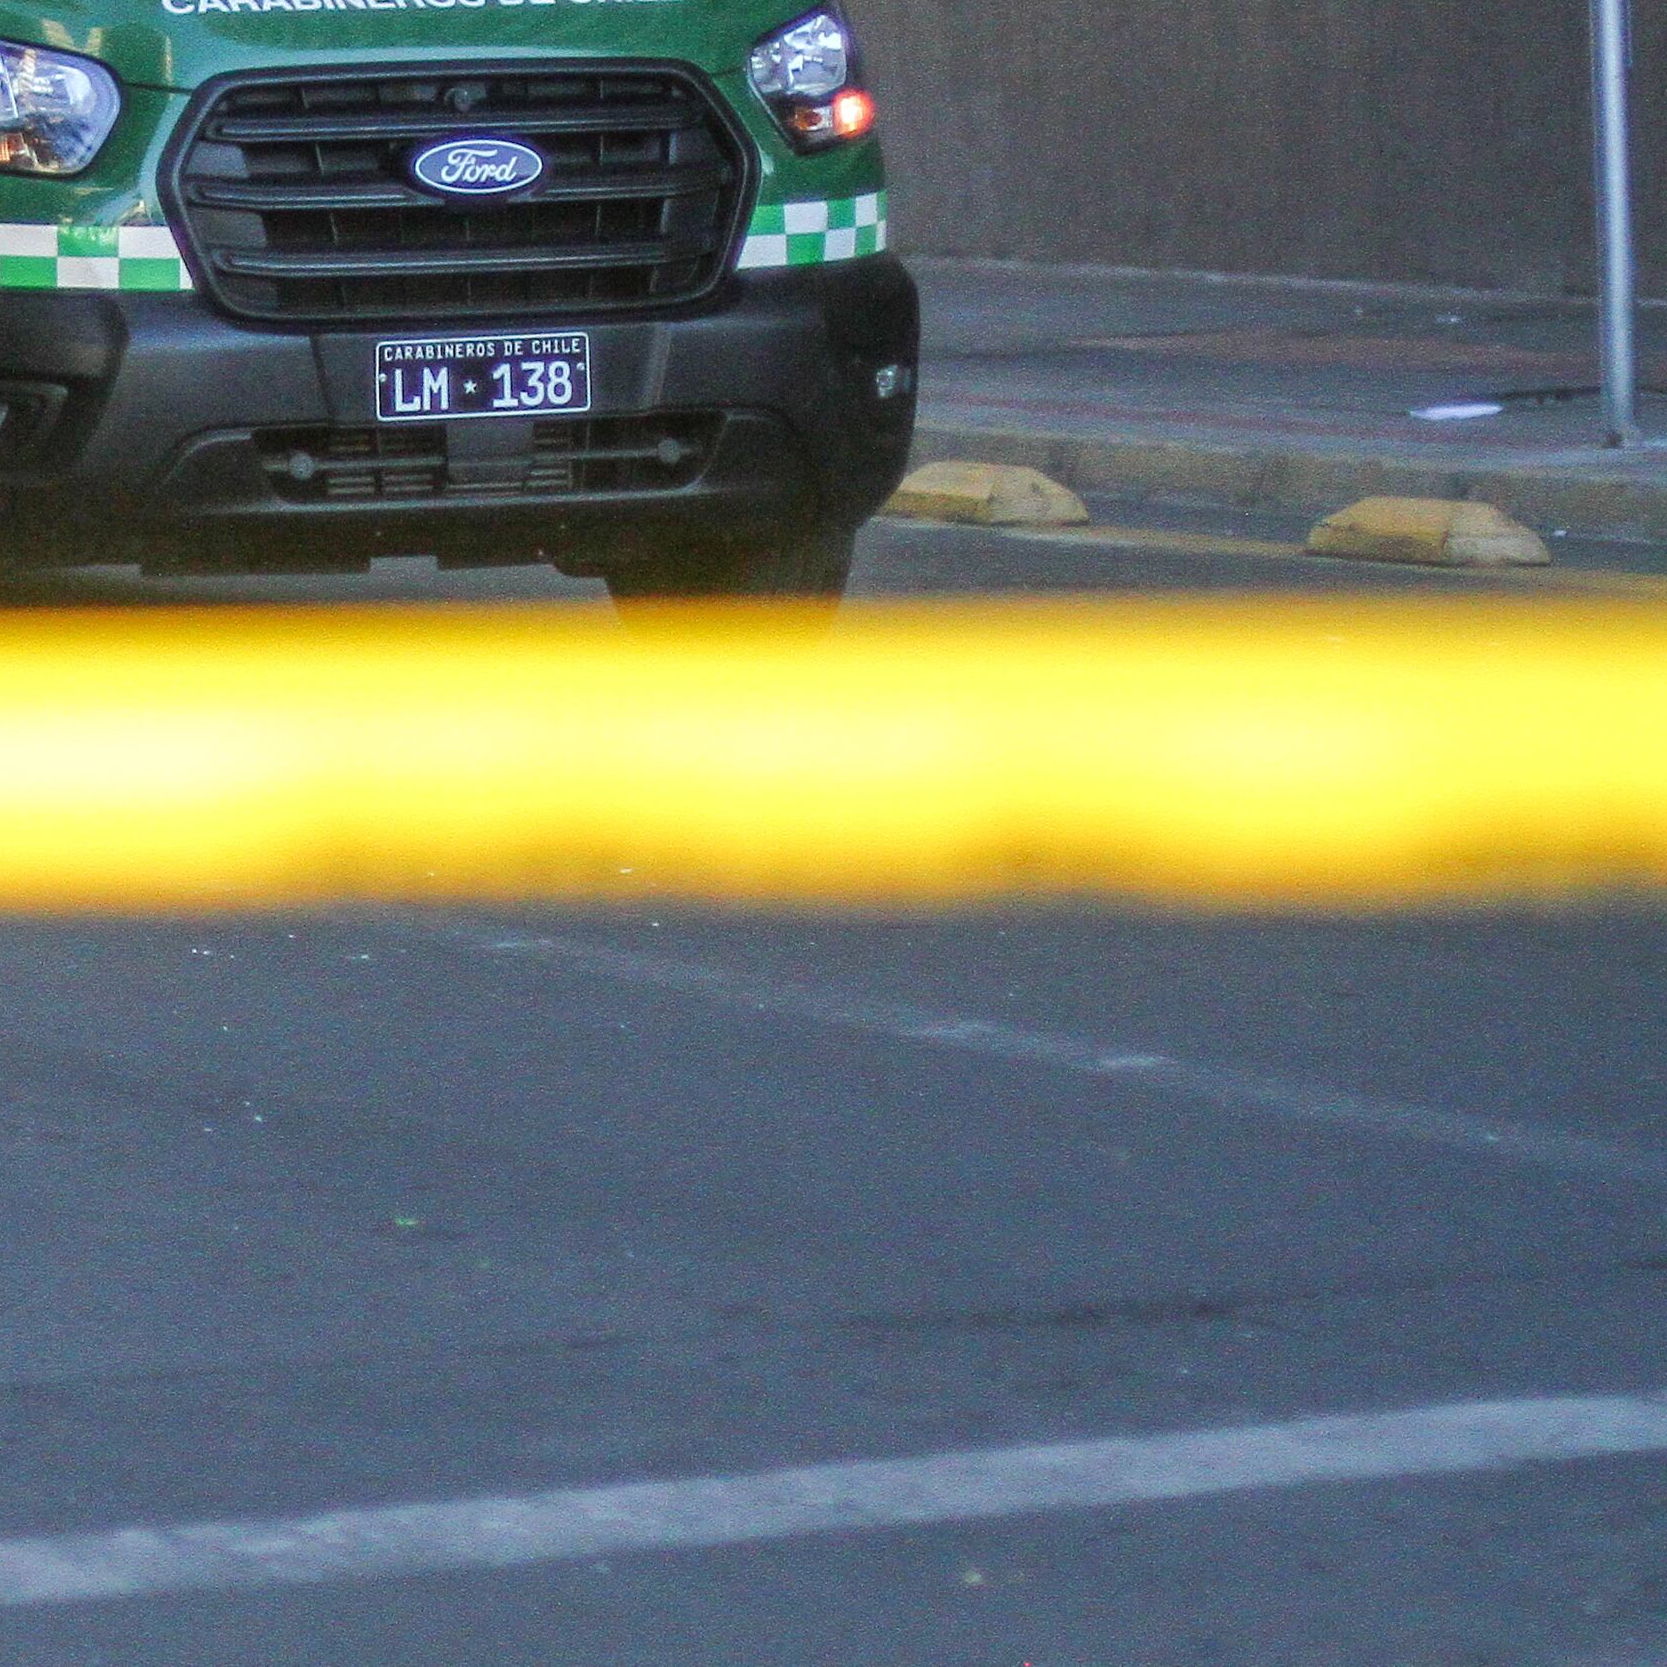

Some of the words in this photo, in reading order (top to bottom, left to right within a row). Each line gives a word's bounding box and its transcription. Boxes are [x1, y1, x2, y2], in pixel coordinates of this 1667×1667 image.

[440, 148, 518, 184] Ford
[383, 342, 495, 362] CARABINEROS
[503, 340, 524, 356] DE
[531, 337, 581, 354] CHILE
[393, 366, 450, 413] LM
[492, 360, 573, 409] 138
